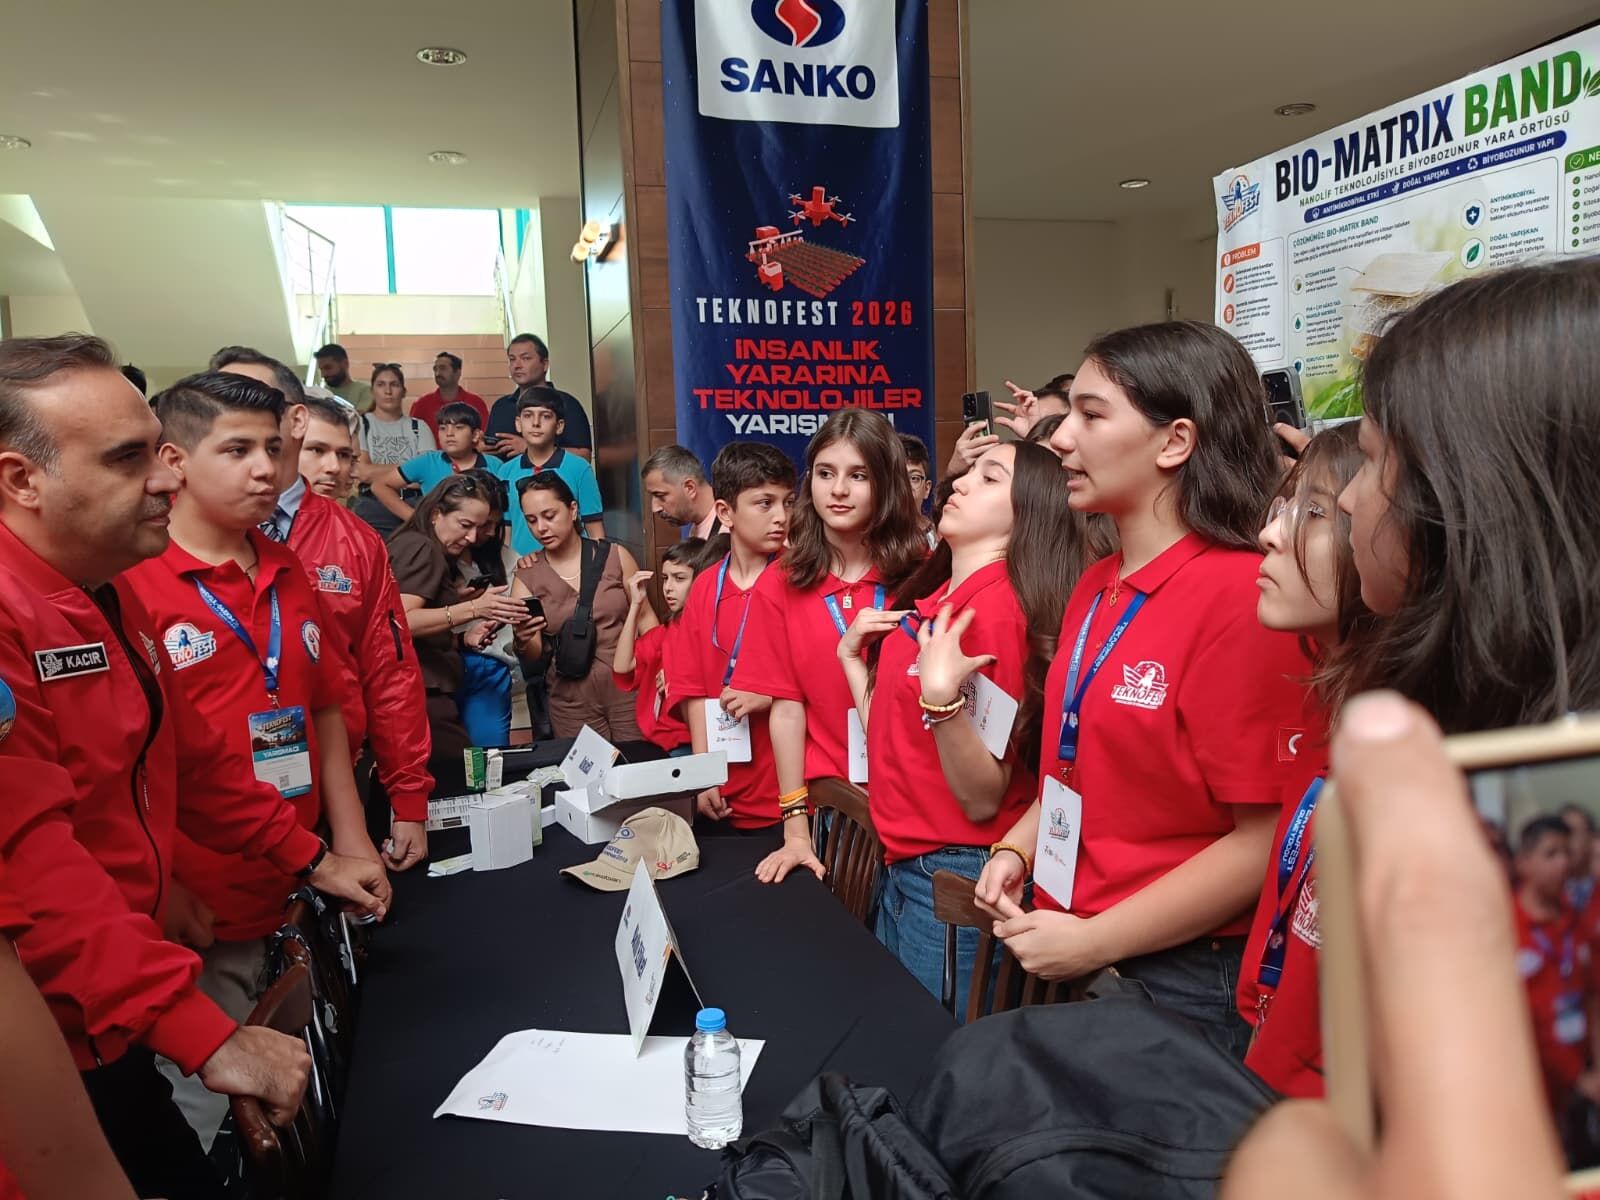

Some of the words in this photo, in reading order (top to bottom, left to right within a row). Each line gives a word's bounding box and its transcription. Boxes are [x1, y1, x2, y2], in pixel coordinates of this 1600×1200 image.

[720, 58, 876, 100] SANKO
[1276, 94, 1454, 202] BIO-MATRIX
[1464, 50, 1582, 137] BAND
[1408, 140, 1479, 170] BİYOBOZUNUR
[1484, 129, 1514, 145] YARA
[1520, 111, 1570, 136] ÖRTÜSÜ
[1536, 137, 1554, 150] YAPI
[1232, 247, 1256, 260] PROBLEM
[697, 298, 838, 326] TEKNOFEST
[852, 300, 912, 326] 2026
[726, 364, 891, 385] YARARINA
[66, 652, 101, 669] KACIR
[1112, 685, 1166, 704] TEKNOFEST
